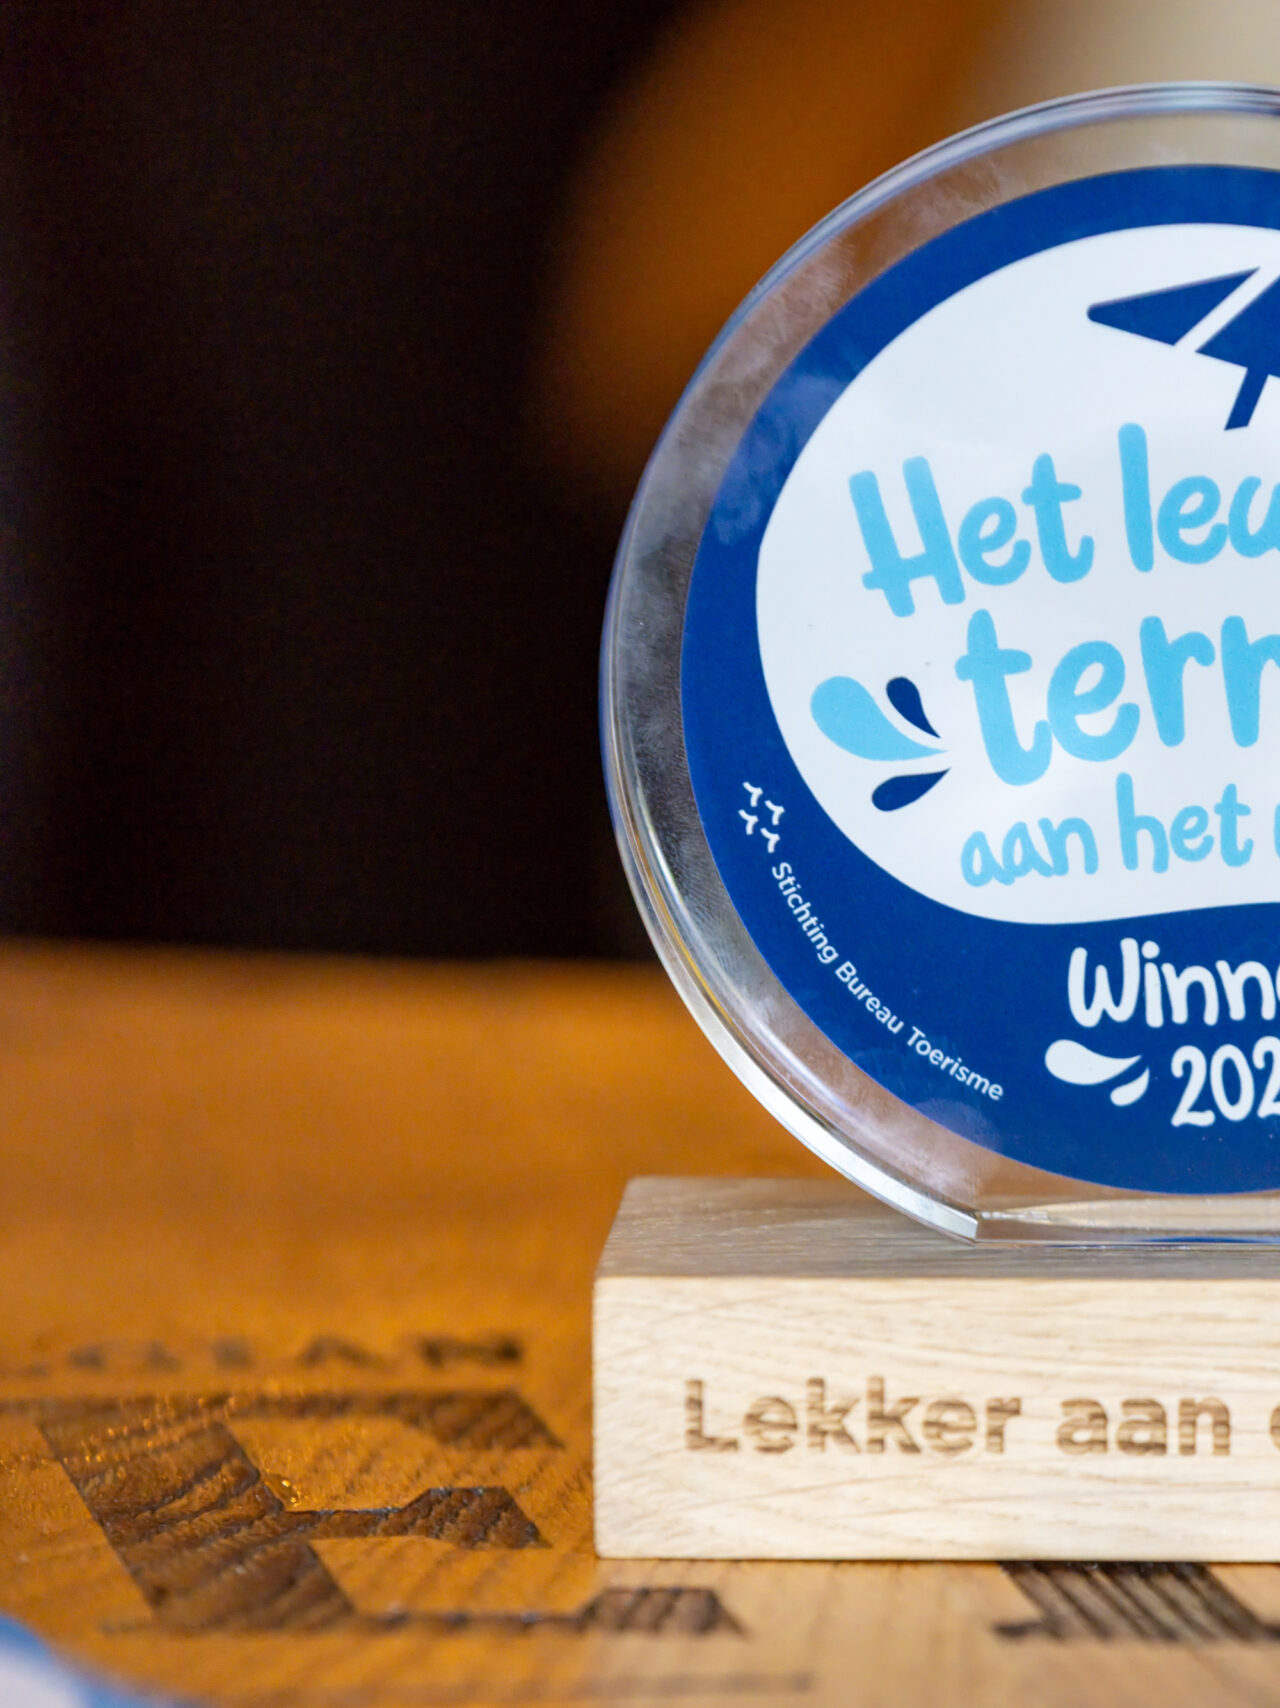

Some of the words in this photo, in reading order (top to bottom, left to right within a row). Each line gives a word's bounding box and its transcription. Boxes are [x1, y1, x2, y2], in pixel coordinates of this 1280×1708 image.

[847, 452, 1096, 619] Het
[959, 816, 1100, 888] aan
[1114, 771, 1256, 874] het
[770, 861, 840, 965] Stichting
[834, 960, 905, 1035] Bureau
[906, 1026, 1005, 1101] Toerisme
[685, 1376, 1022, 1455] Lekker
[1055, 1397, 1231, 1456] aan
